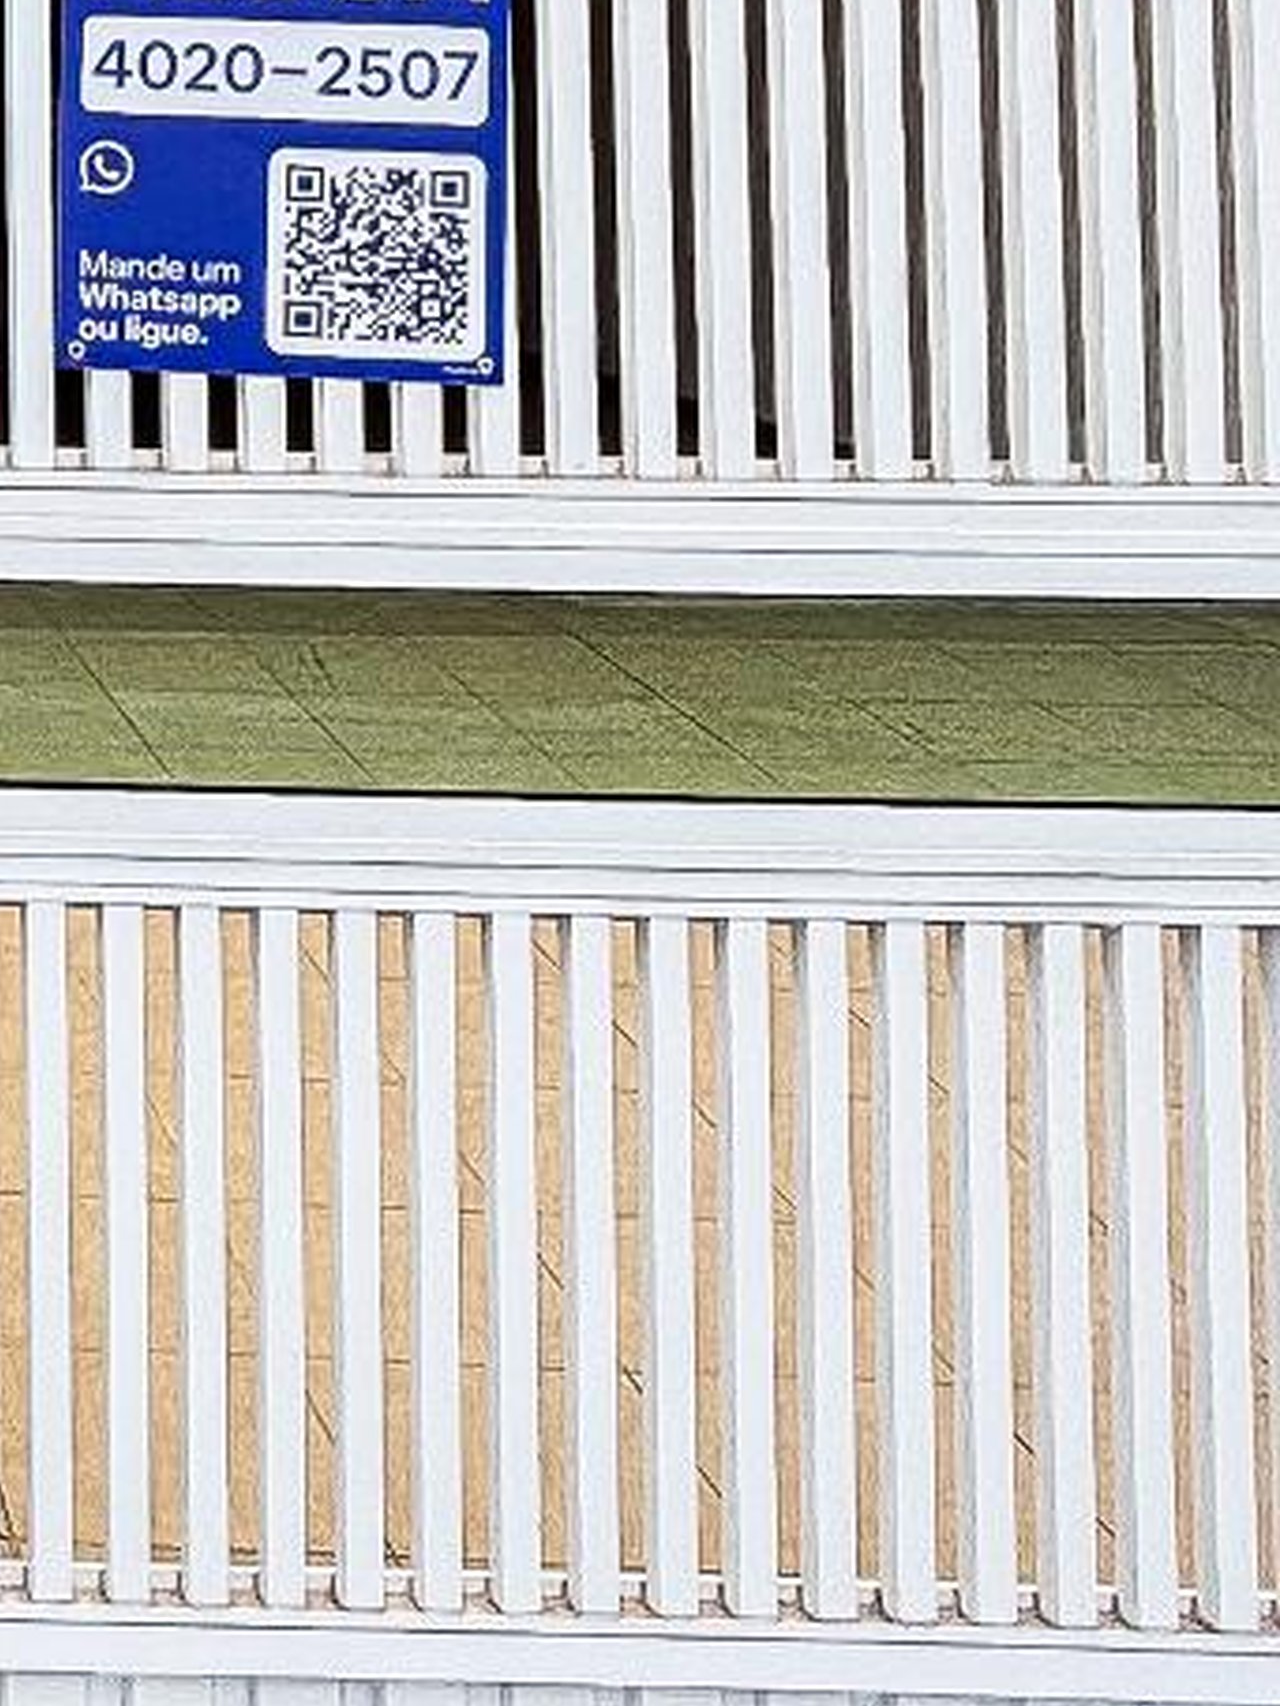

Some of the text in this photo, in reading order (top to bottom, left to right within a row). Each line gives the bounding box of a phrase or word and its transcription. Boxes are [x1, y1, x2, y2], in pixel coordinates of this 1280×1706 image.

[91, 39, 480, 102] 4020-2507
[79, 249, 241, 285] Mande um
[79, 281, 241, 322] Whatsapp
[79, 313, 209, 350] ou ligue.
